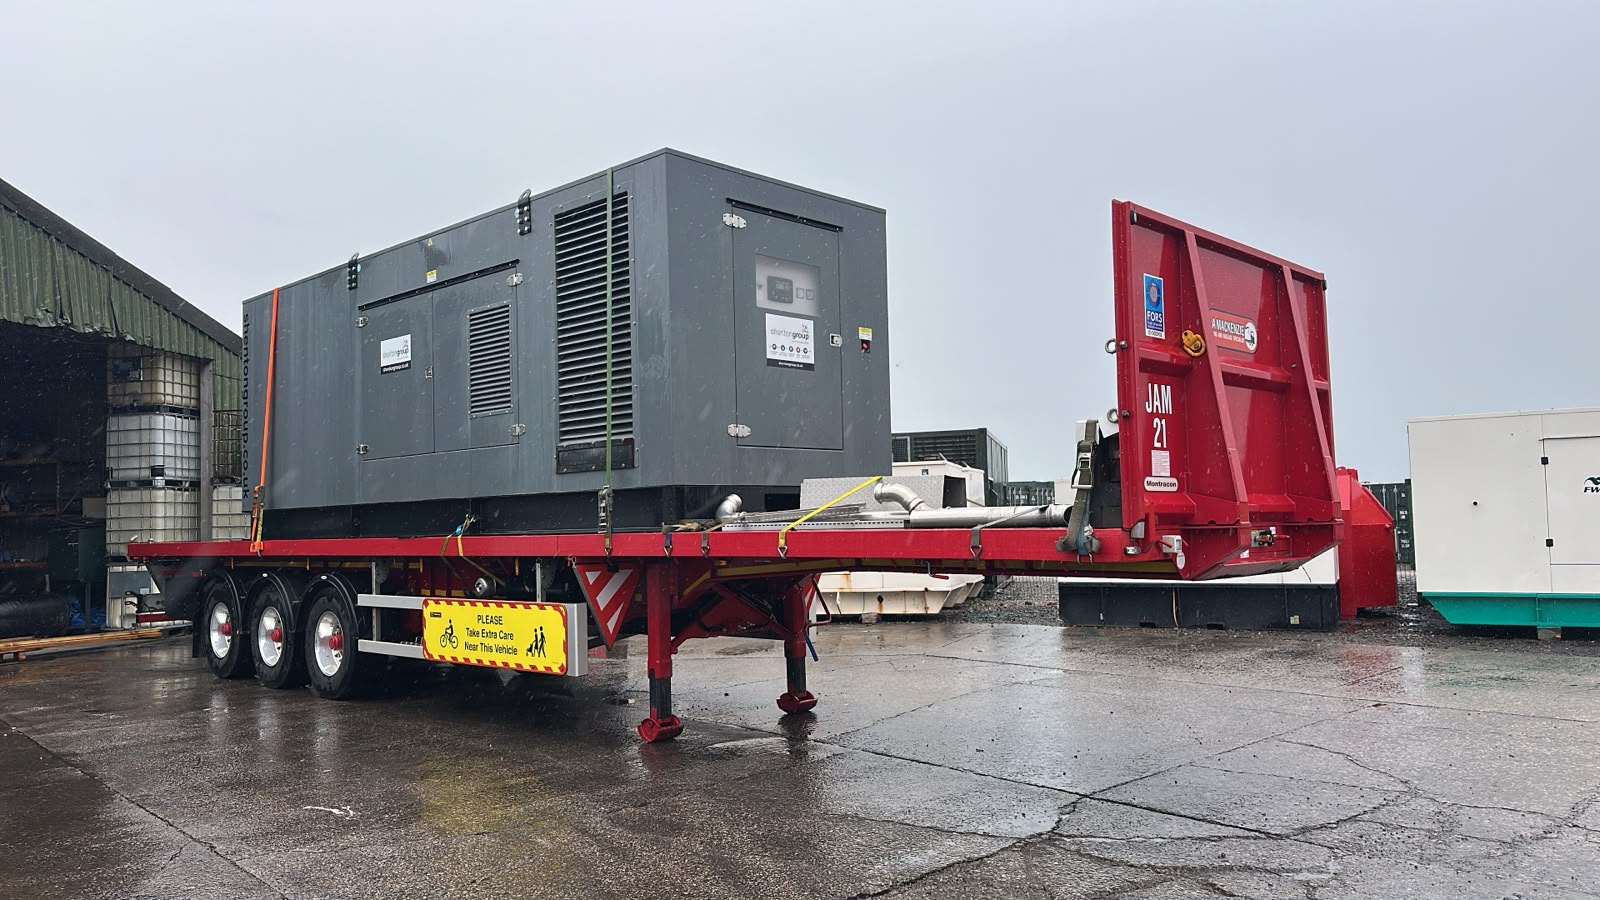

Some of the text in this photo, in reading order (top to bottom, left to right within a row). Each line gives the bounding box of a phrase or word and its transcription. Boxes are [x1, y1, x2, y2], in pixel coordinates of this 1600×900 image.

[1147, 310, 1163, 323] FORS
[1216, 318, 1245, 336] MACKENZIE
[1145, 383, 1173, 414] JAM
[242, 313, 251, 499] shentongroup.co.uk
[1153, 417, 1167, 449] 21
[1146, 480, 1177, 488] Montracon
[477, 614, 503, 625] PLEASE
[466, 627, 514, 640] Take Extra Care
[464, 641, 518, 655] Near This Vehicle
